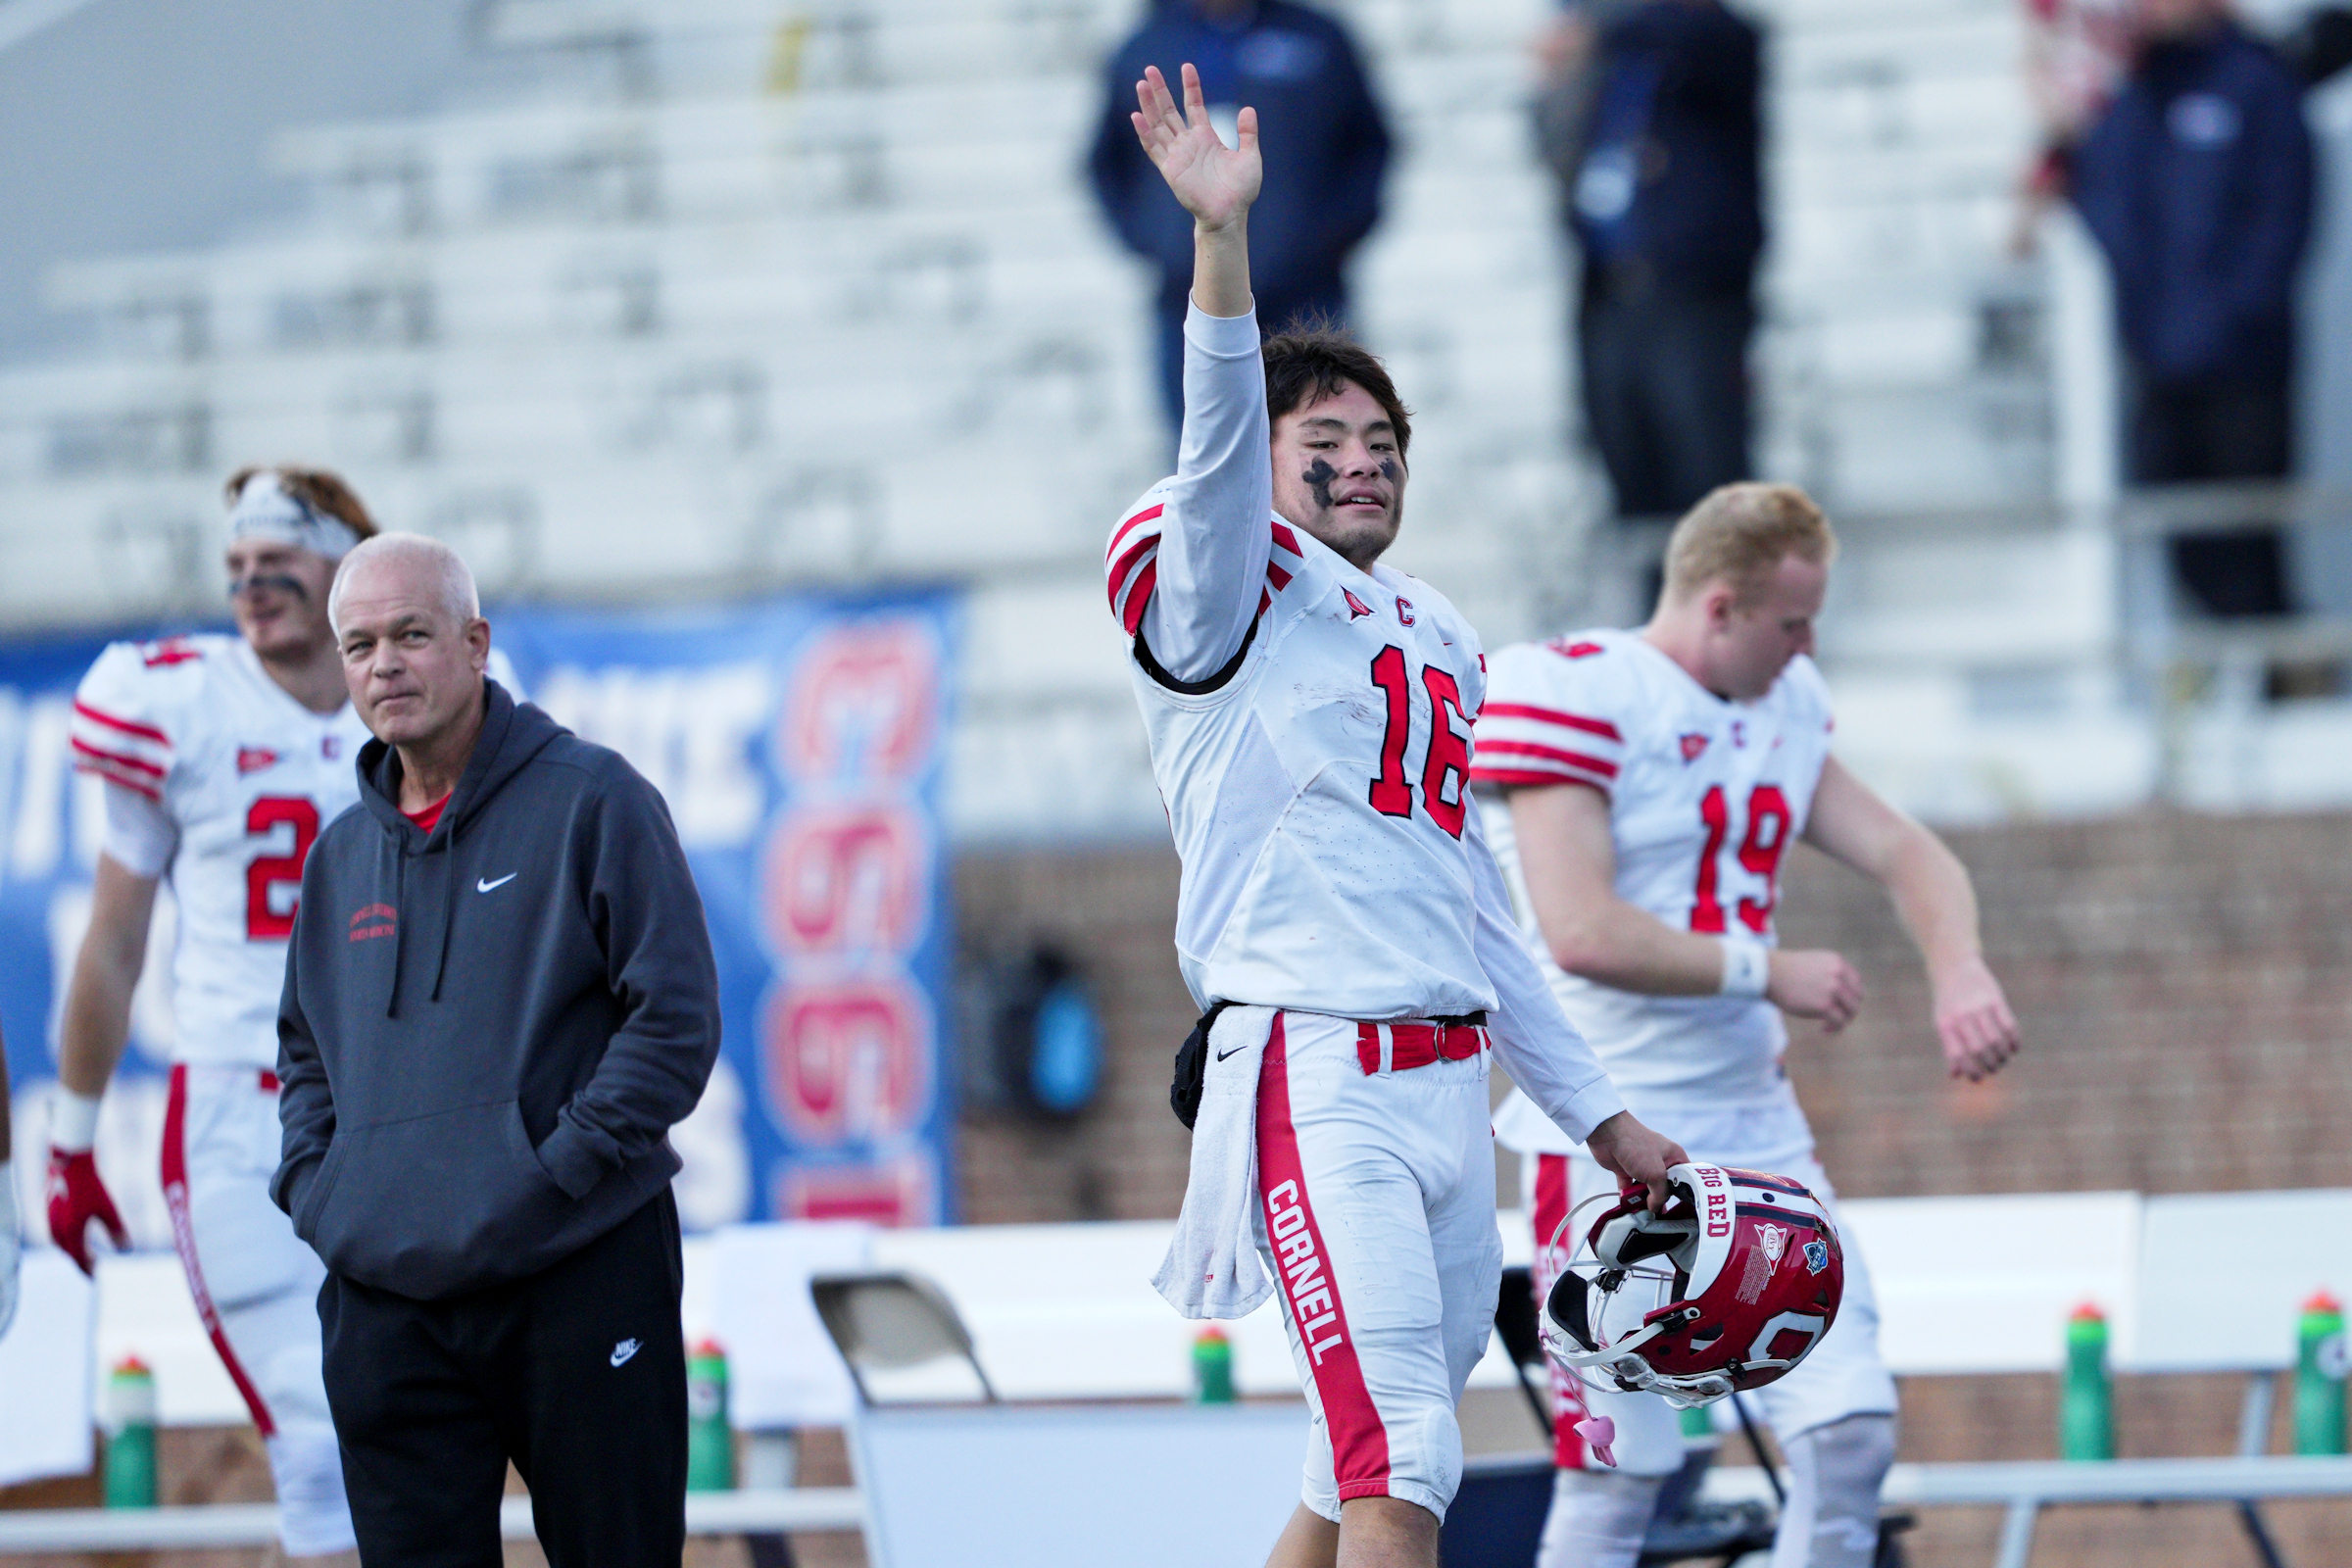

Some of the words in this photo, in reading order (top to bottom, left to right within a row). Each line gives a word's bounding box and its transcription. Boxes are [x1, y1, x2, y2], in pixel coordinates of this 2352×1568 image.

[1396, 595, 1415, 627] C
[1370, 644, 1470, 841] 16
[1690, 784, 1790, 934] 19
[1694, 1167, 1723, 1189] BIG
[1707, 1194, 1731, 1238] RED
[1267, 1178, 1345, 1366] CORNELL
[615, 1338, 637, 1357] NIKE
